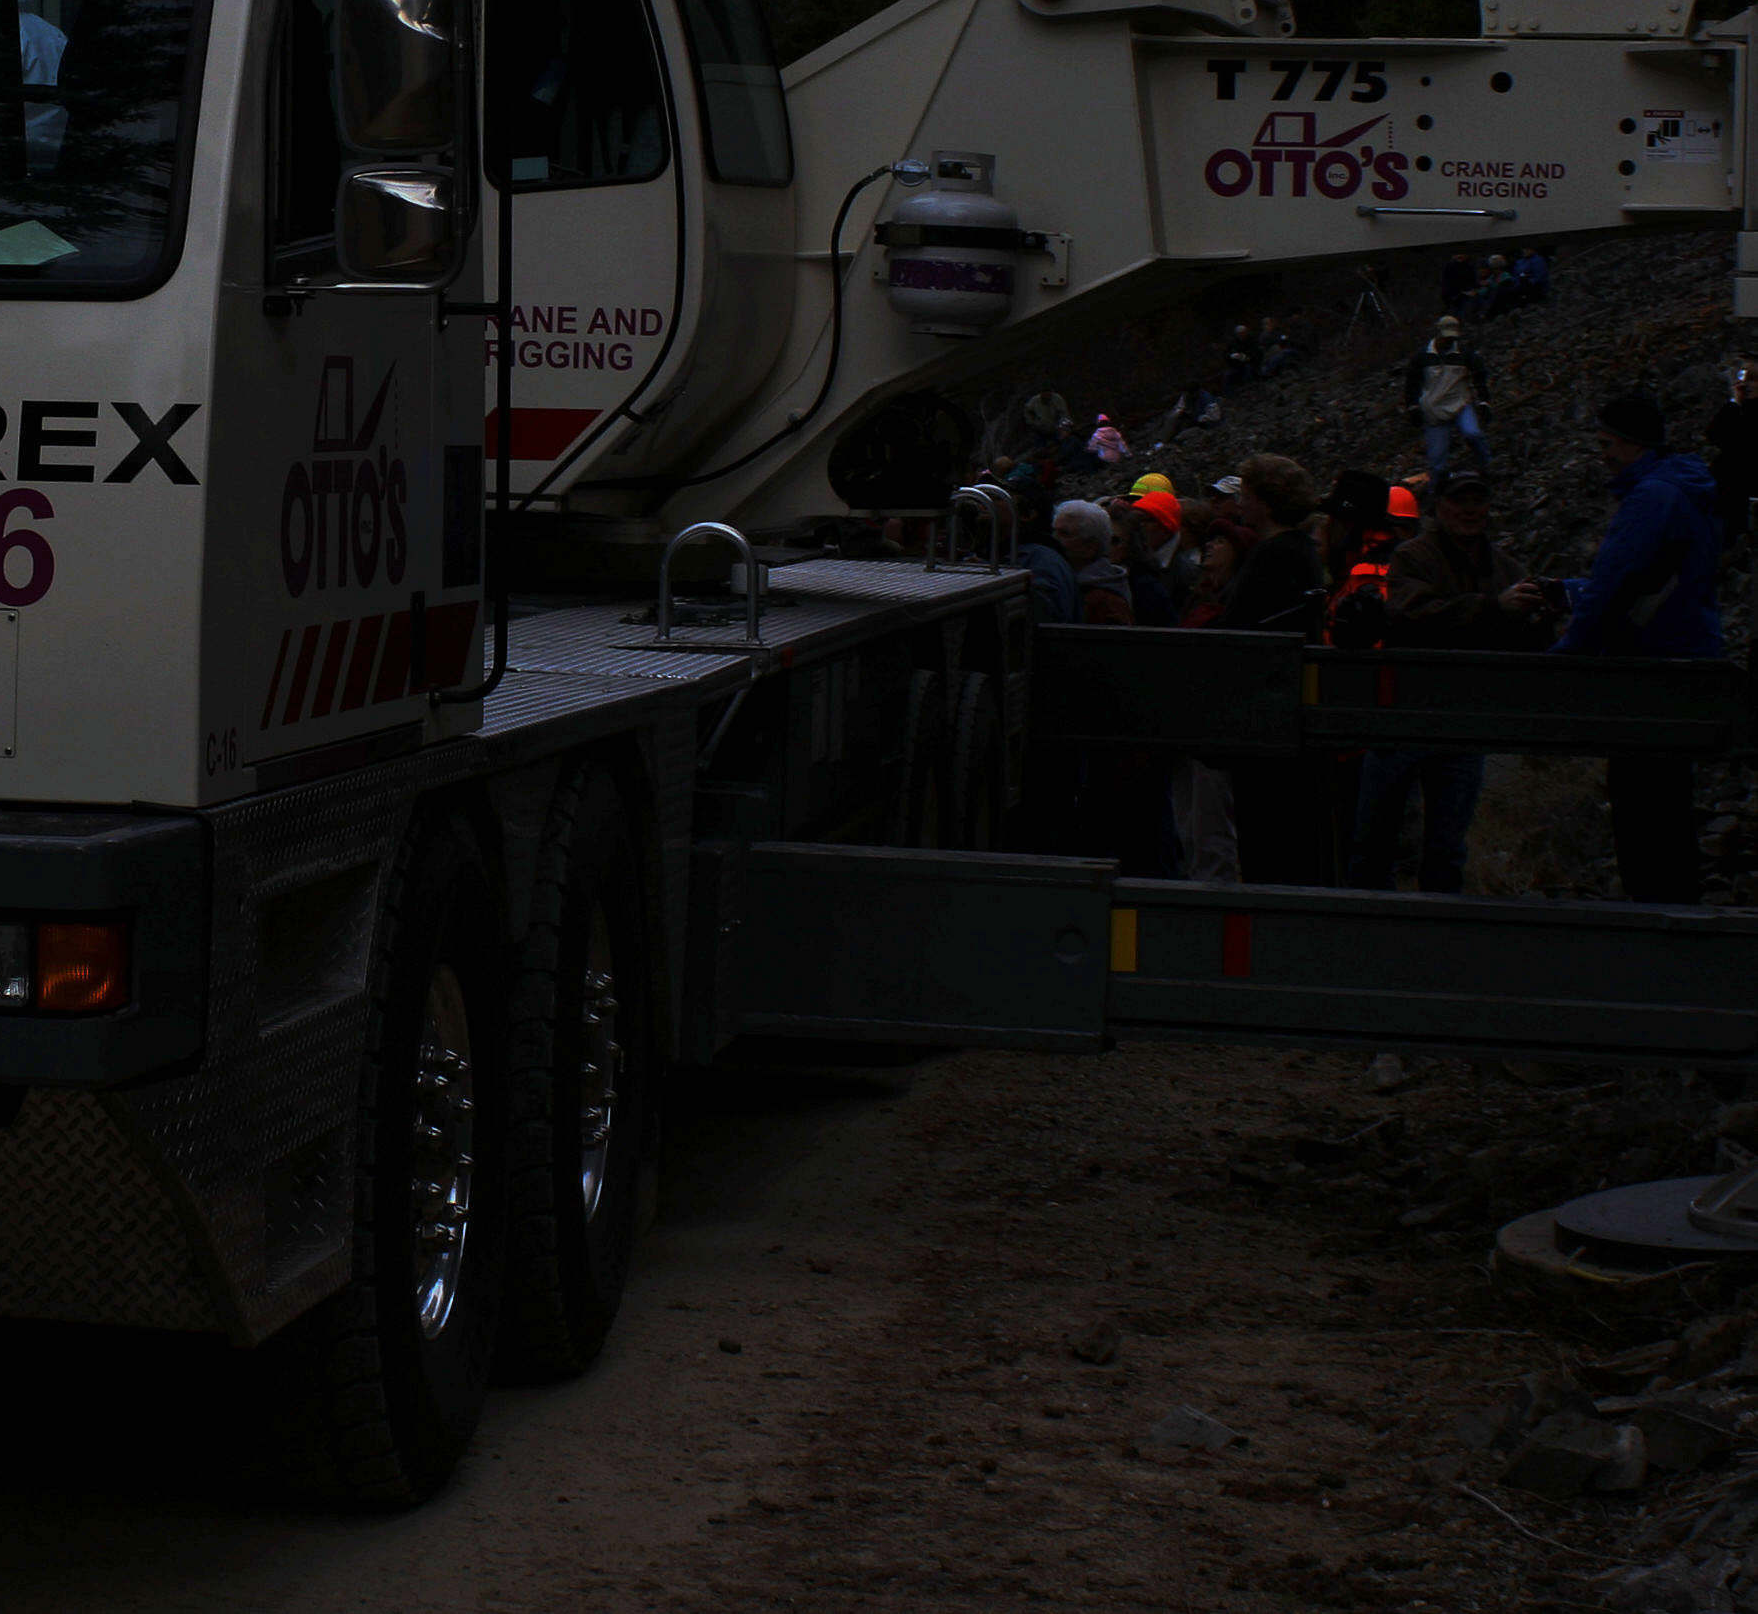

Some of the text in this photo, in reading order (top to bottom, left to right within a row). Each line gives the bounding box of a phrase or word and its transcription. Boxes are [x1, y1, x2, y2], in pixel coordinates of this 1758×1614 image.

[1207, 60, 1388, 102] T 775
[1205, 145, 1409, 200] OTTO'S
[1442, 161, 1565, 180] CRANE AND
[1457, 181, 1548, 199] RIGGING
[586, 307, 663, 336] AND
[484, 339, 634, 371] RIGGING
[280, 445, 408, 598] OTTO'S
[205, 727, 238, 776] C-16
